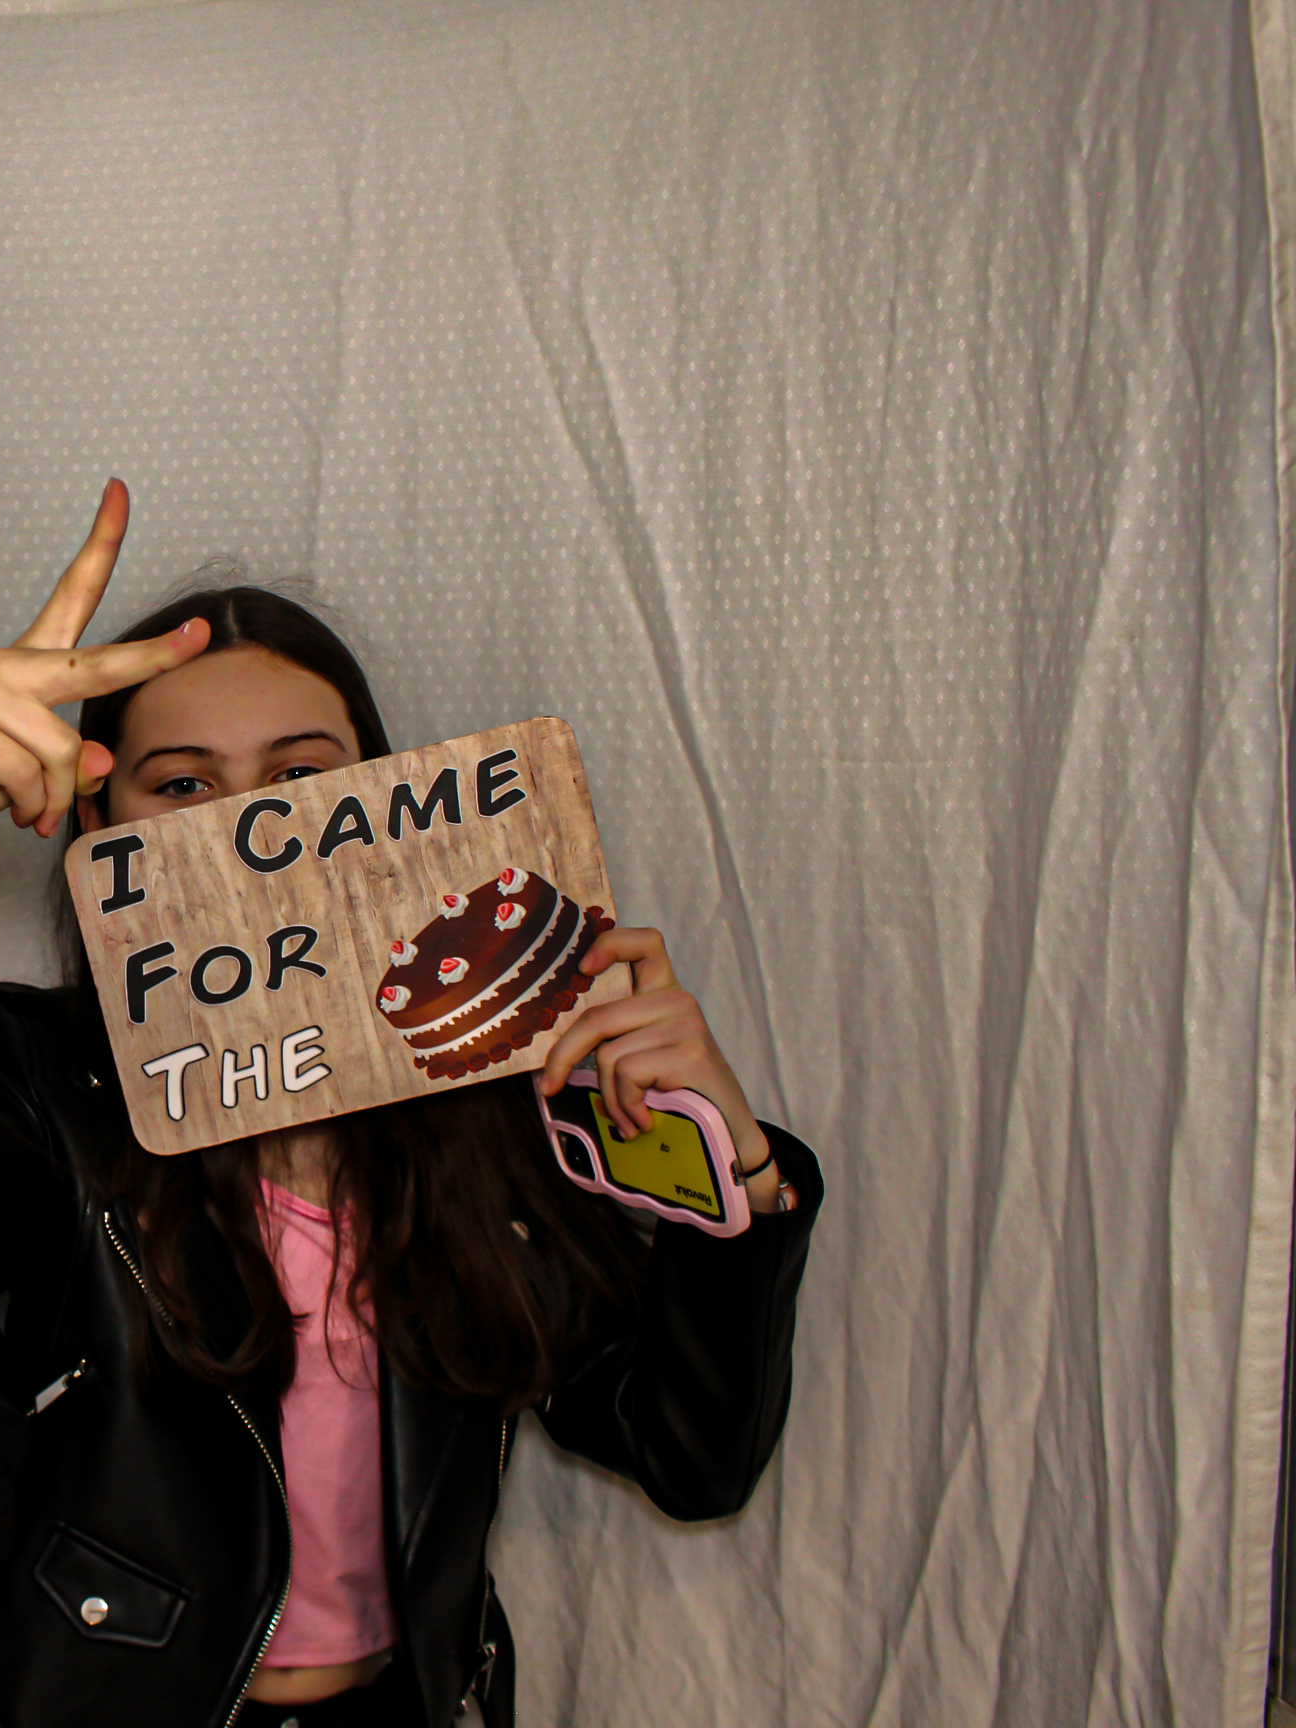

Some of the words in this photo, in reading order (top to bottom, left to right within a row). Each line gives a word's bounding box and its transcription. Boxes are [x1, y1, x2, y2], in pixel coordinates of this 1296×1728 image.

[91, 834, 146, 914] I
[235, 749, 526, 873] CAME
[125, 925, 327, 1024] FOR
[141, 1025, 332, 1121] THE
[674, 1184, 712, 1206] Revolut
